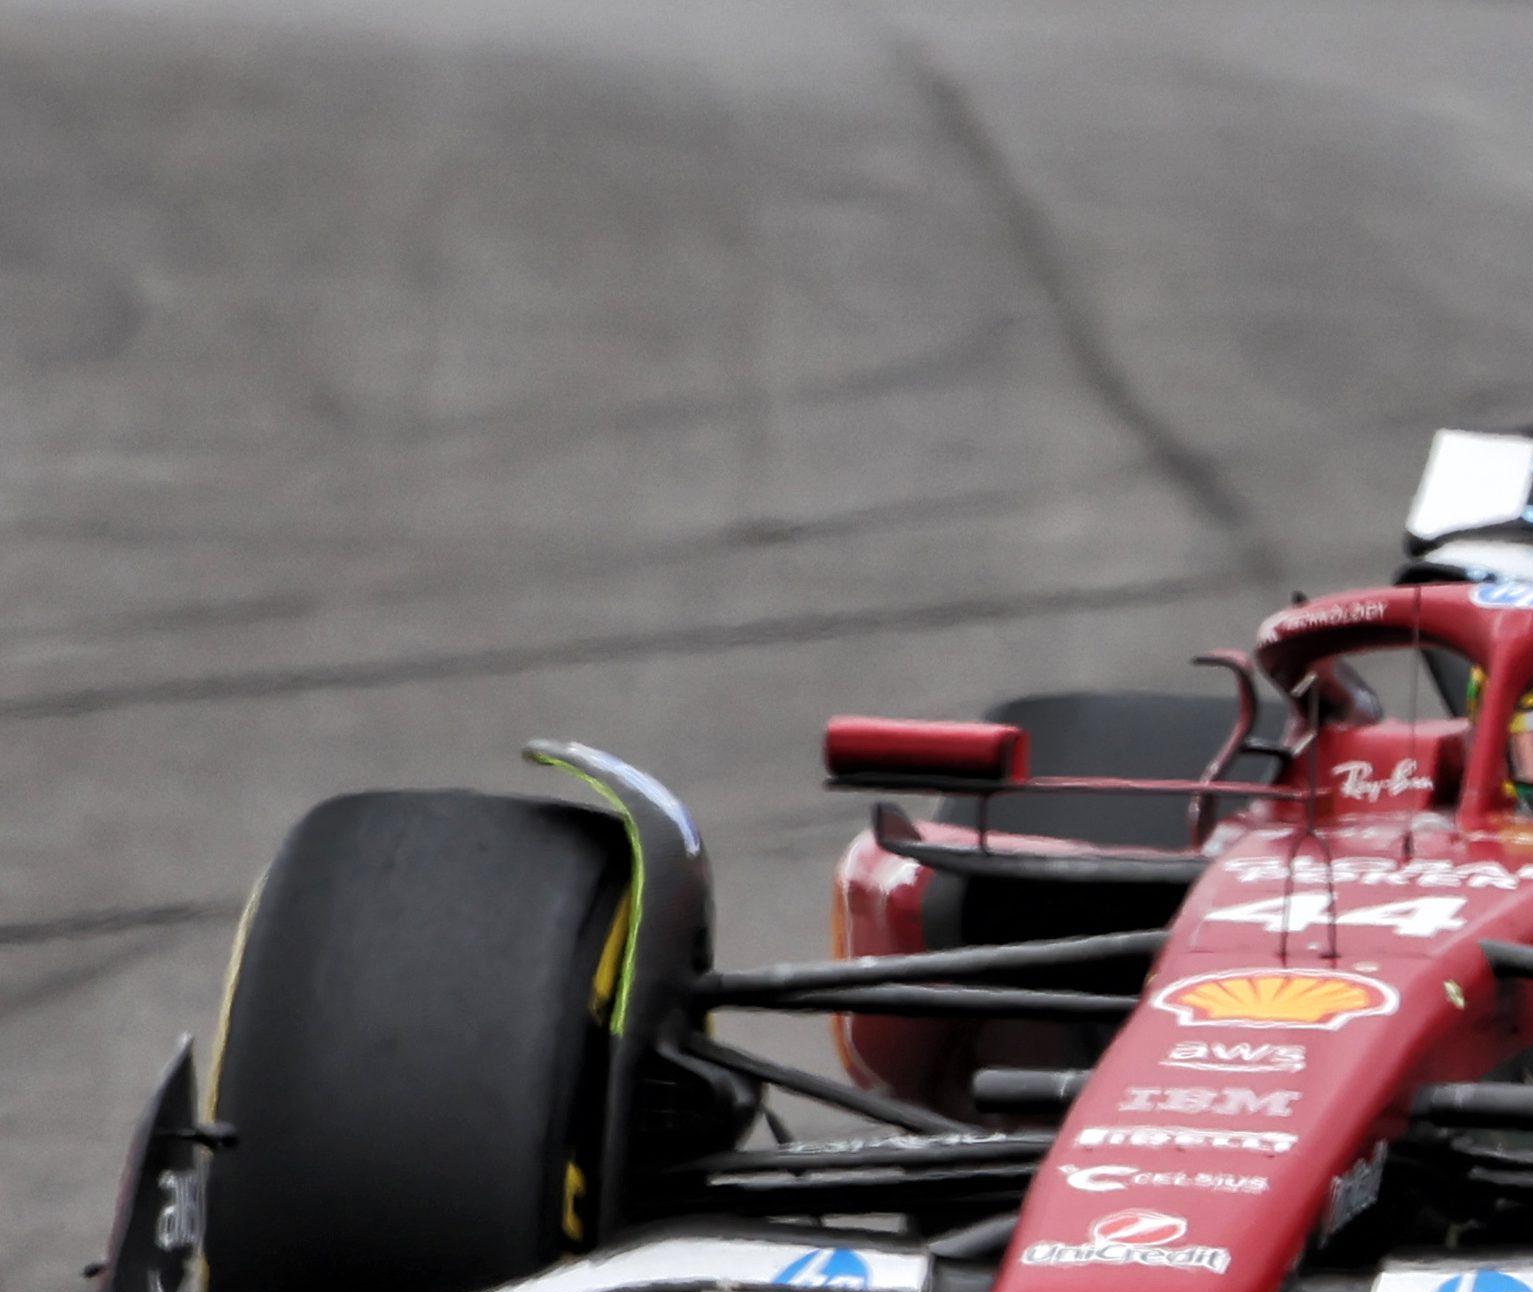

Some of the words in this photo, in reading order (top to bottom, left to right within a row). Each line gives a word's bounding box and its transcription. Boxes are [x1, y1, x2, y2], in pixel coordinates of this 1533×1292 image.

[1203, 892, 1470, 938] 44
[1168, 1041, 1307, 1065] aws
[1117, 1086, 1302, 1117] IBM
[1020, 1242, 1231, 1275] UniCredit
